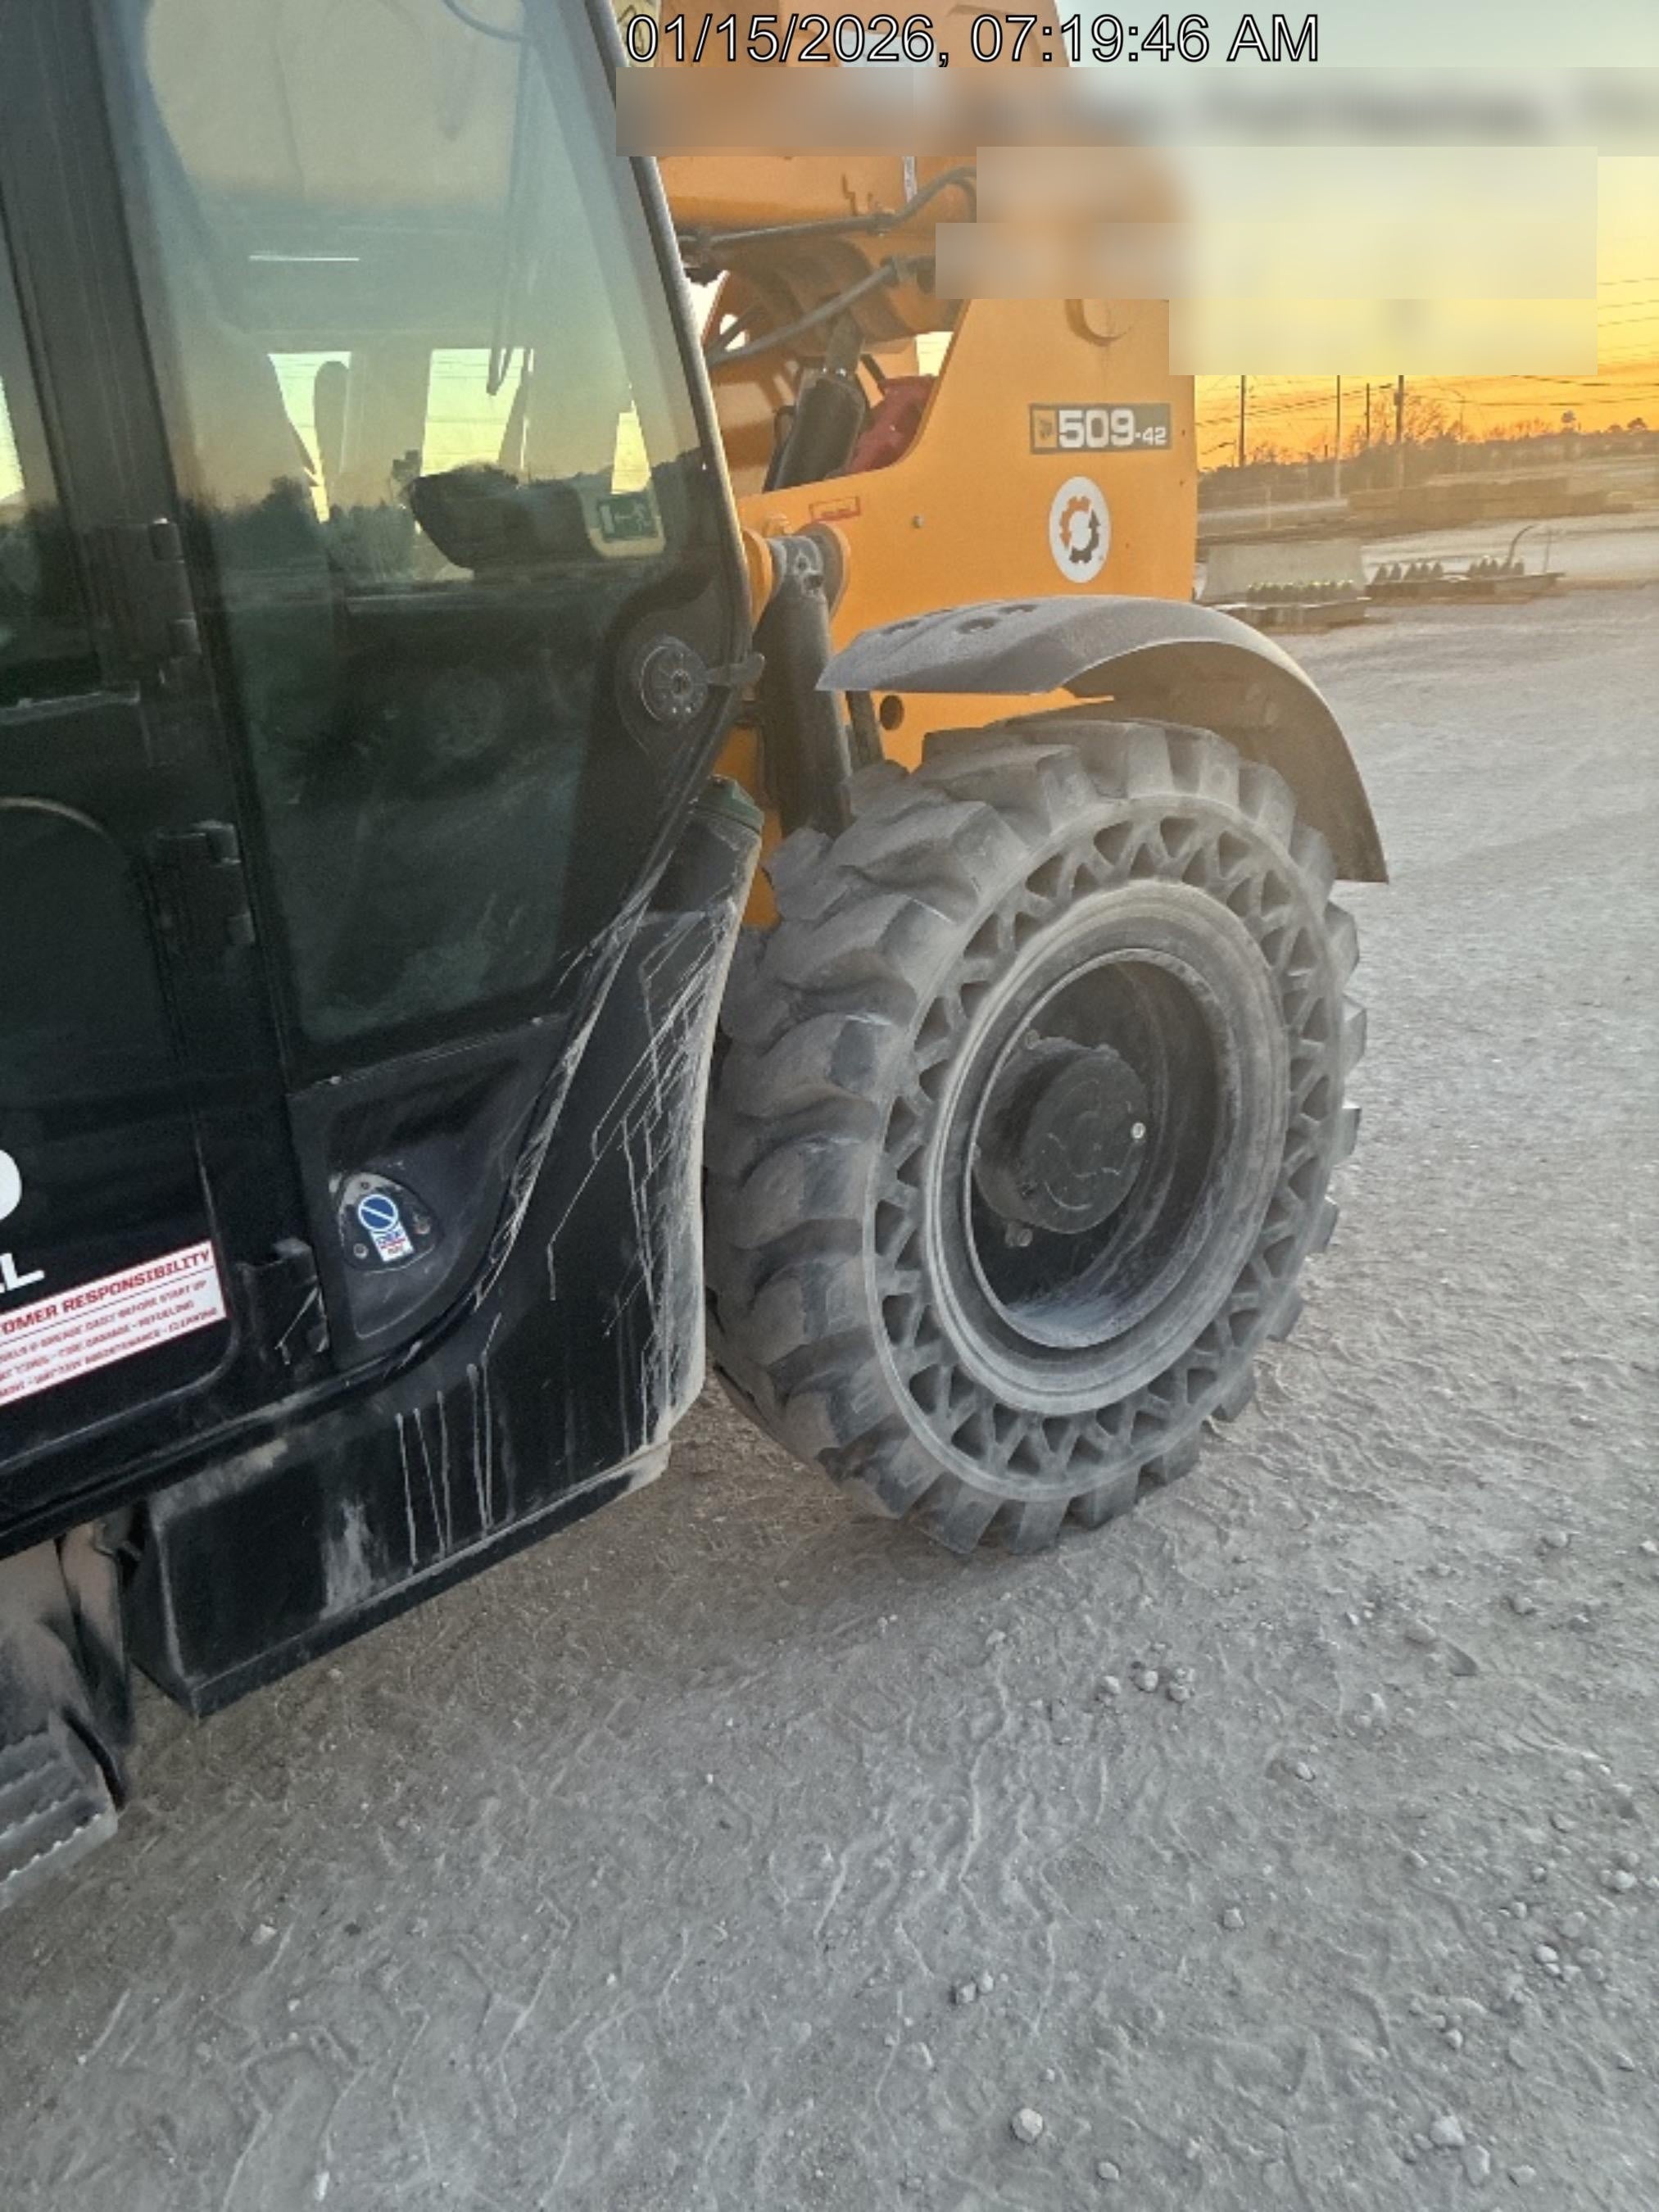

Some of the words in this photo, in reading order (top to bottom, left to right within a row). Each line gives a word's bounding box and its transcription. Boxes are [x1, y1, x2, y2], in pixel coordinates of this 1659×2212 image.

[0, 1253, 45, 1294] L
[0, 1305, 58, 1335] OMER
[62, 1249, 210, 1312] RESPONSIBILITY
